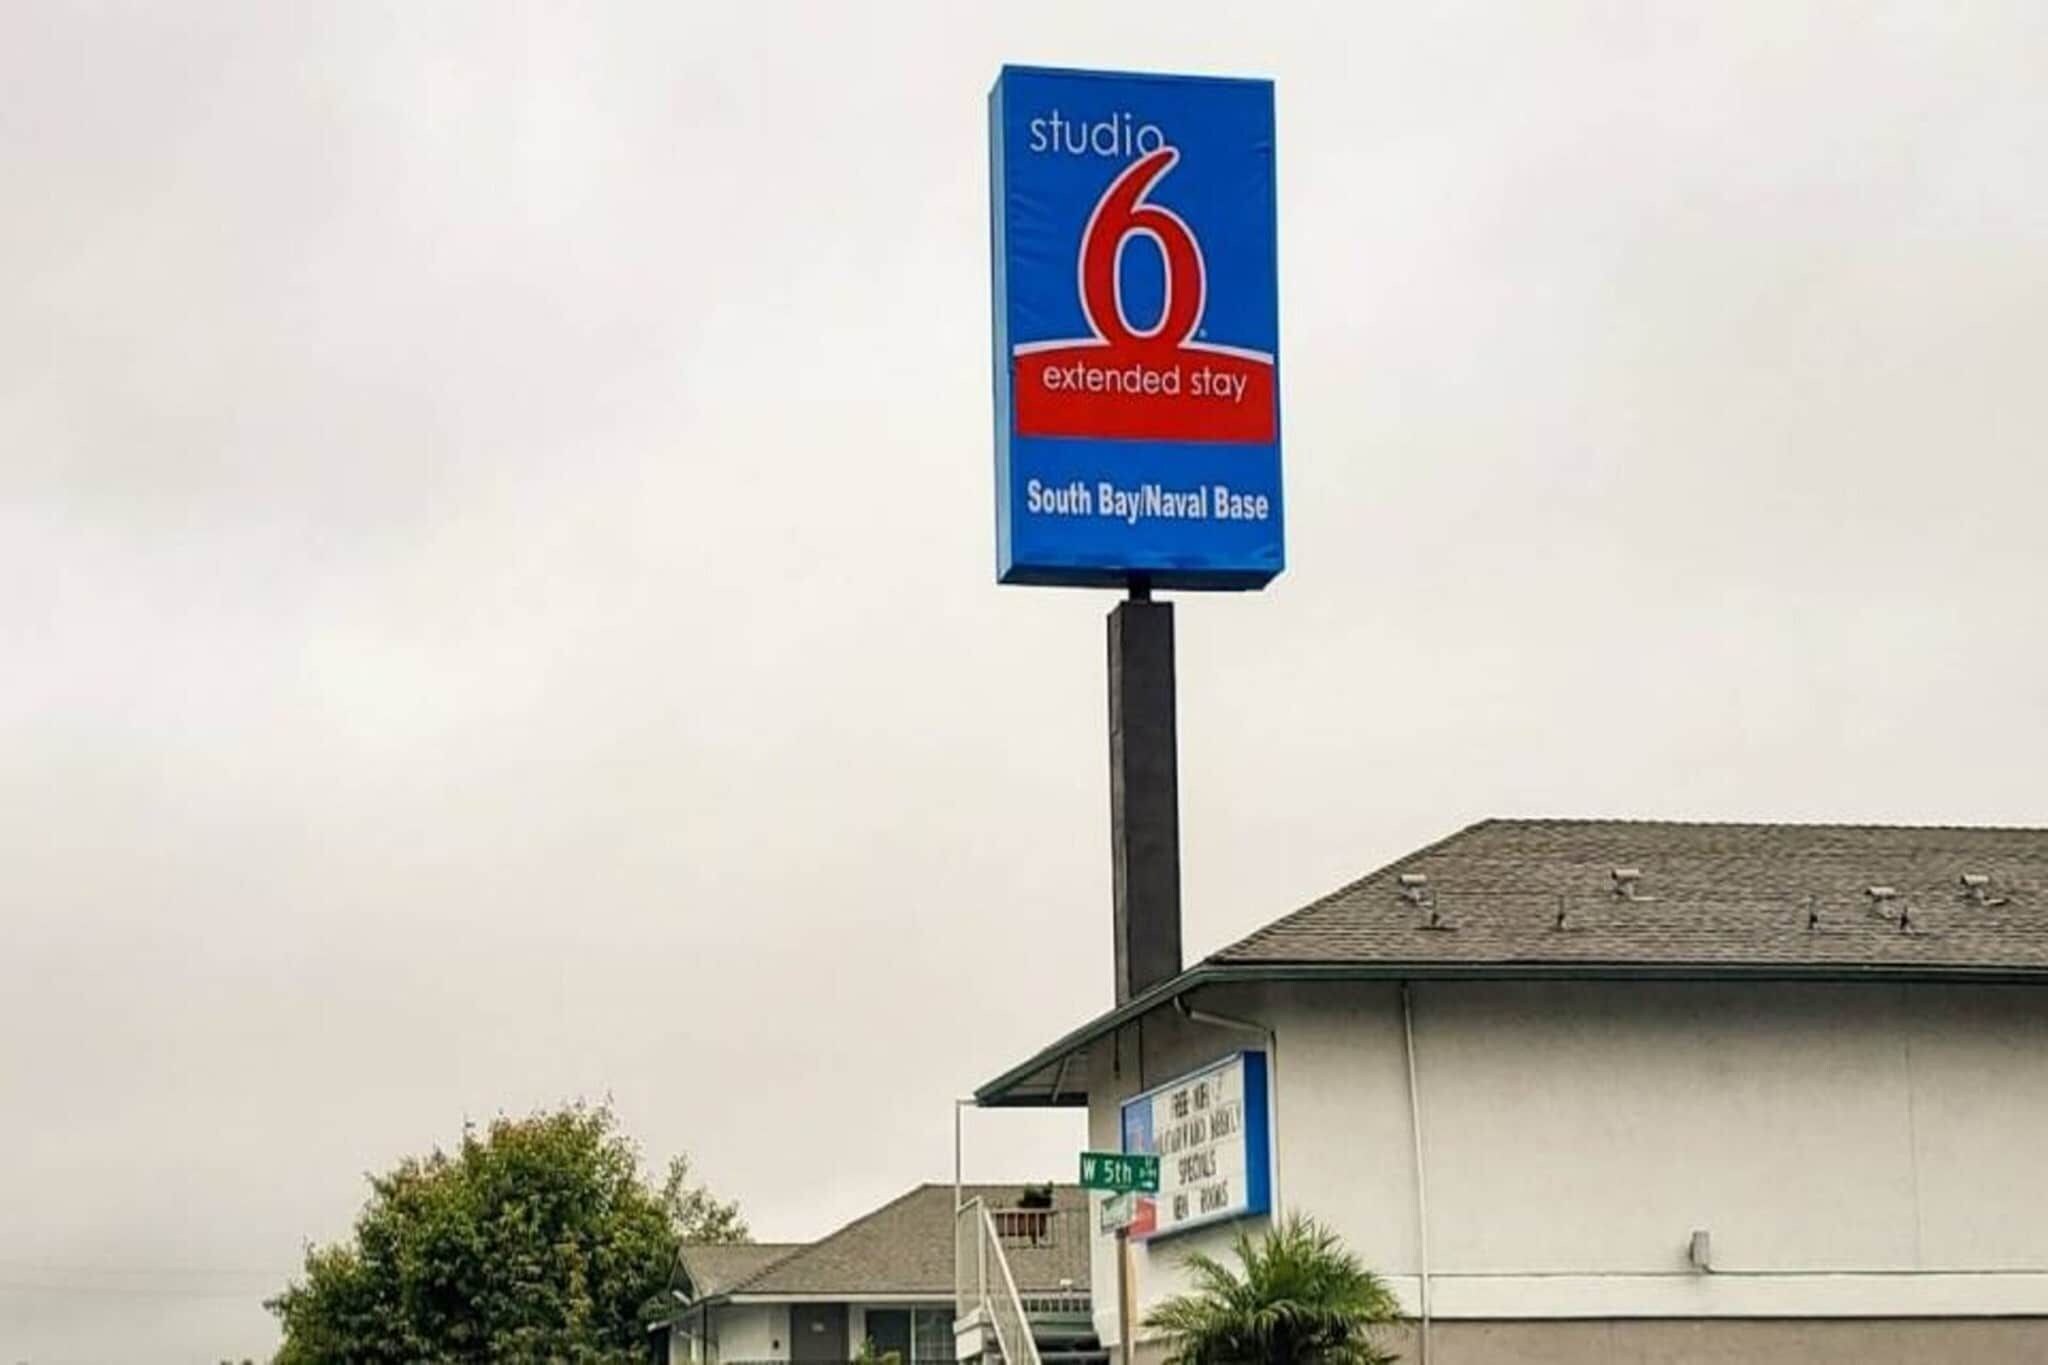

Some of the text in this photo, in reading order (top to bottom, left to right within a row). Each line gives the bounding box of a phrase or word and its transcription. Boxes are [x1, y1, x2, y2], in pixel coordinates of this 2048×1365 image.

[1029, 108, 1164, 157] studio
[1077, 145, 1207, 346] 6
[1043, 360, 1247, 402] extended stay
[1027, 478, 1269, 525] South Bay/Naval Base
[1083, 1157, 1096, 1182] W
[1103, 1158, 1132, 1185] 5th
